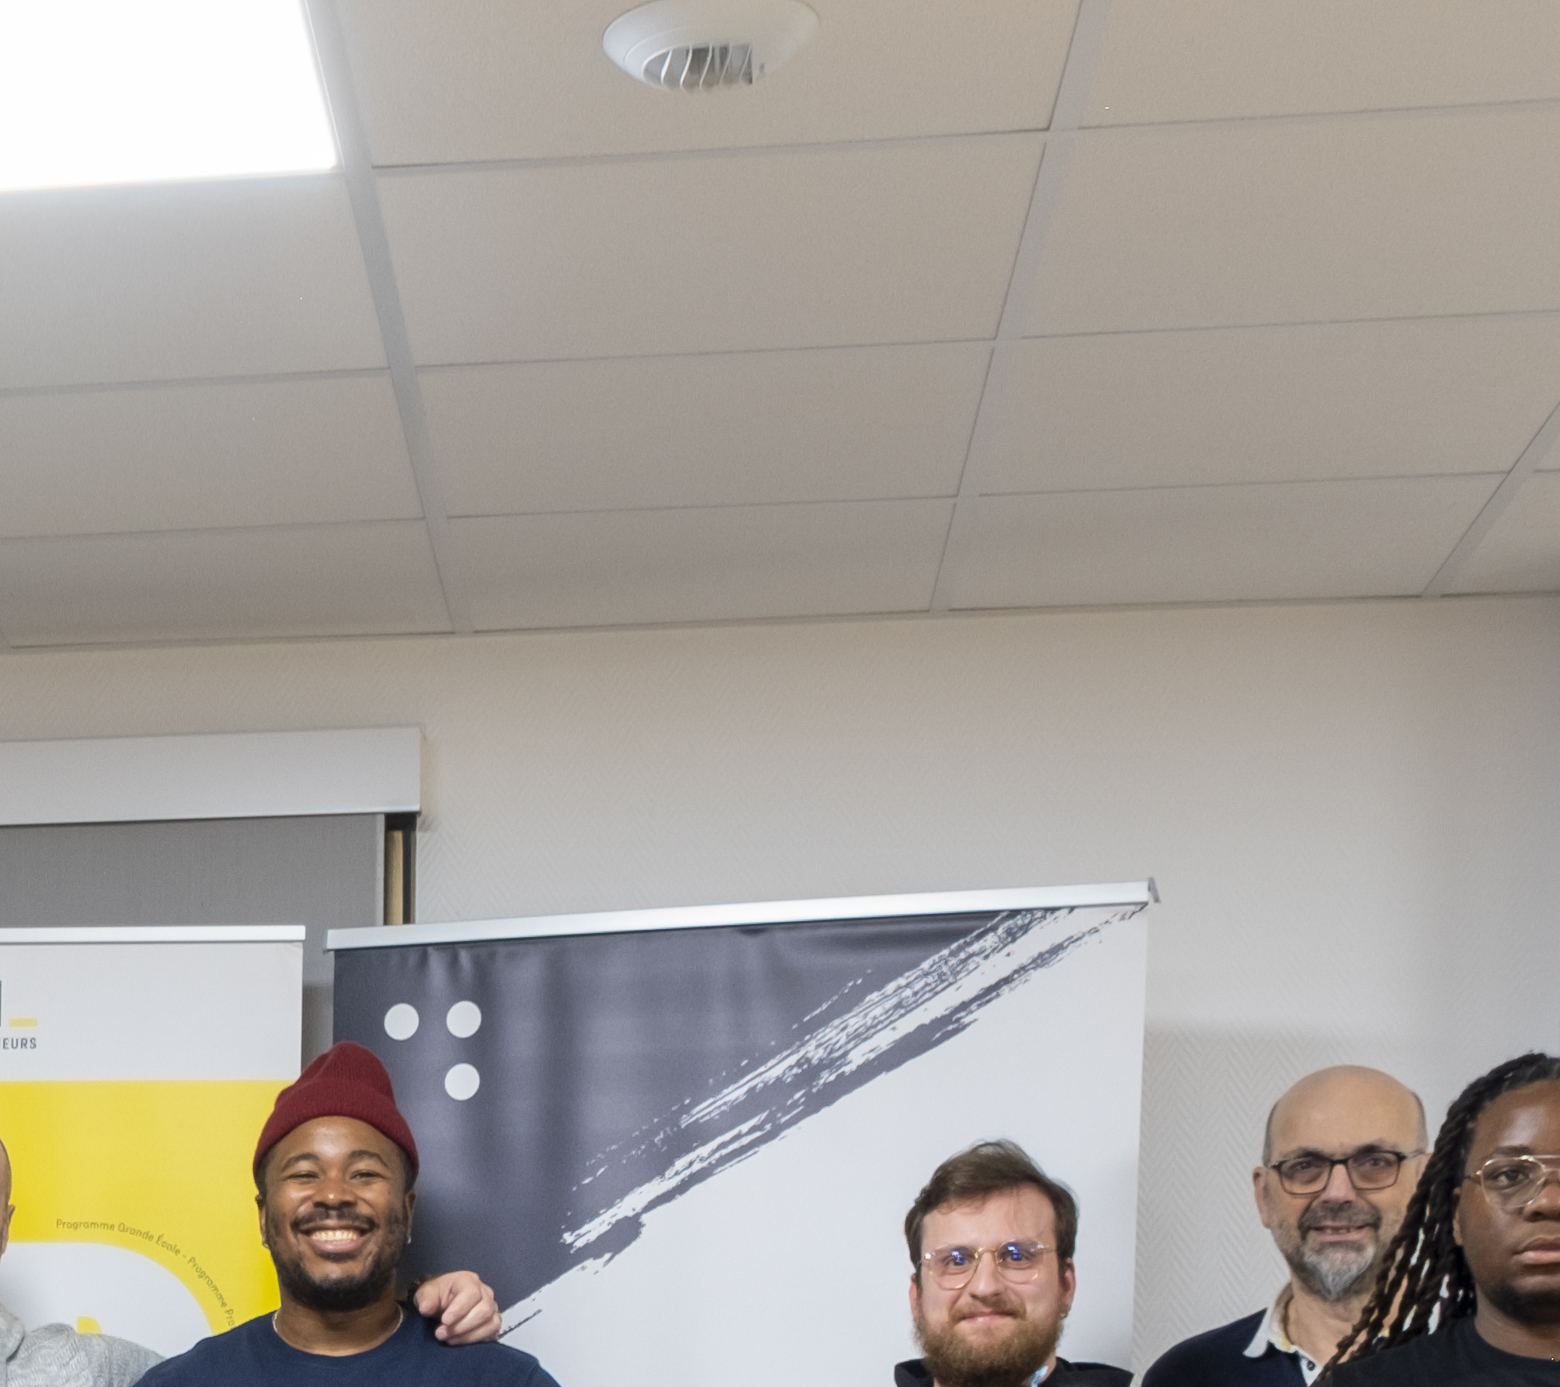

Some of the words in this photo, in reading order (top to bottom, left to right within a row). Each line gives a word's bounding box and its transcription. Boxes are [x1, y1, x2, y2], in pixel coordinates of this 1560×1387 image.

[55, 1218, 116, 1232] Programme
[117, 1222, 155, 1242] Grande
[187, 1256, 228, 1309] Programme
